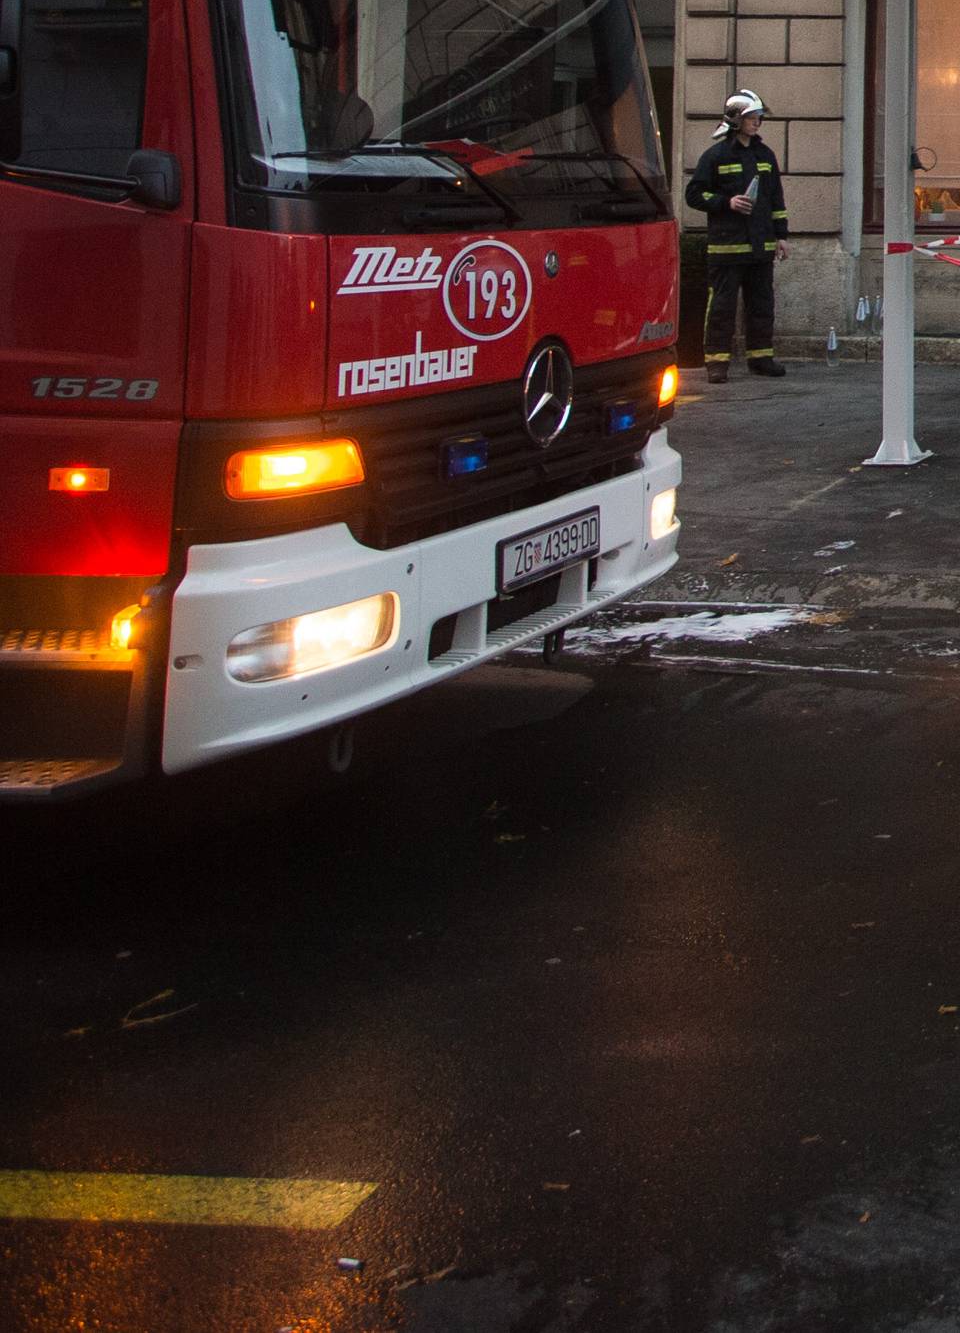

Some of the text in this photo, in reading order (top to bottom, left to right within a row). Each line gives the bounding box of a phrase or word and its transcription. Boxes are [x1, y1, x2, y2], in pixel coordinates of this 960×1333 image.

[341, 246, 443, 286] Metz
[465, 269, 517, 320] 193
[338, 330, 478, 397] rosenbauer
[32, 377, 160, 401] 1528
[514, 540, 533, 577] ZG
